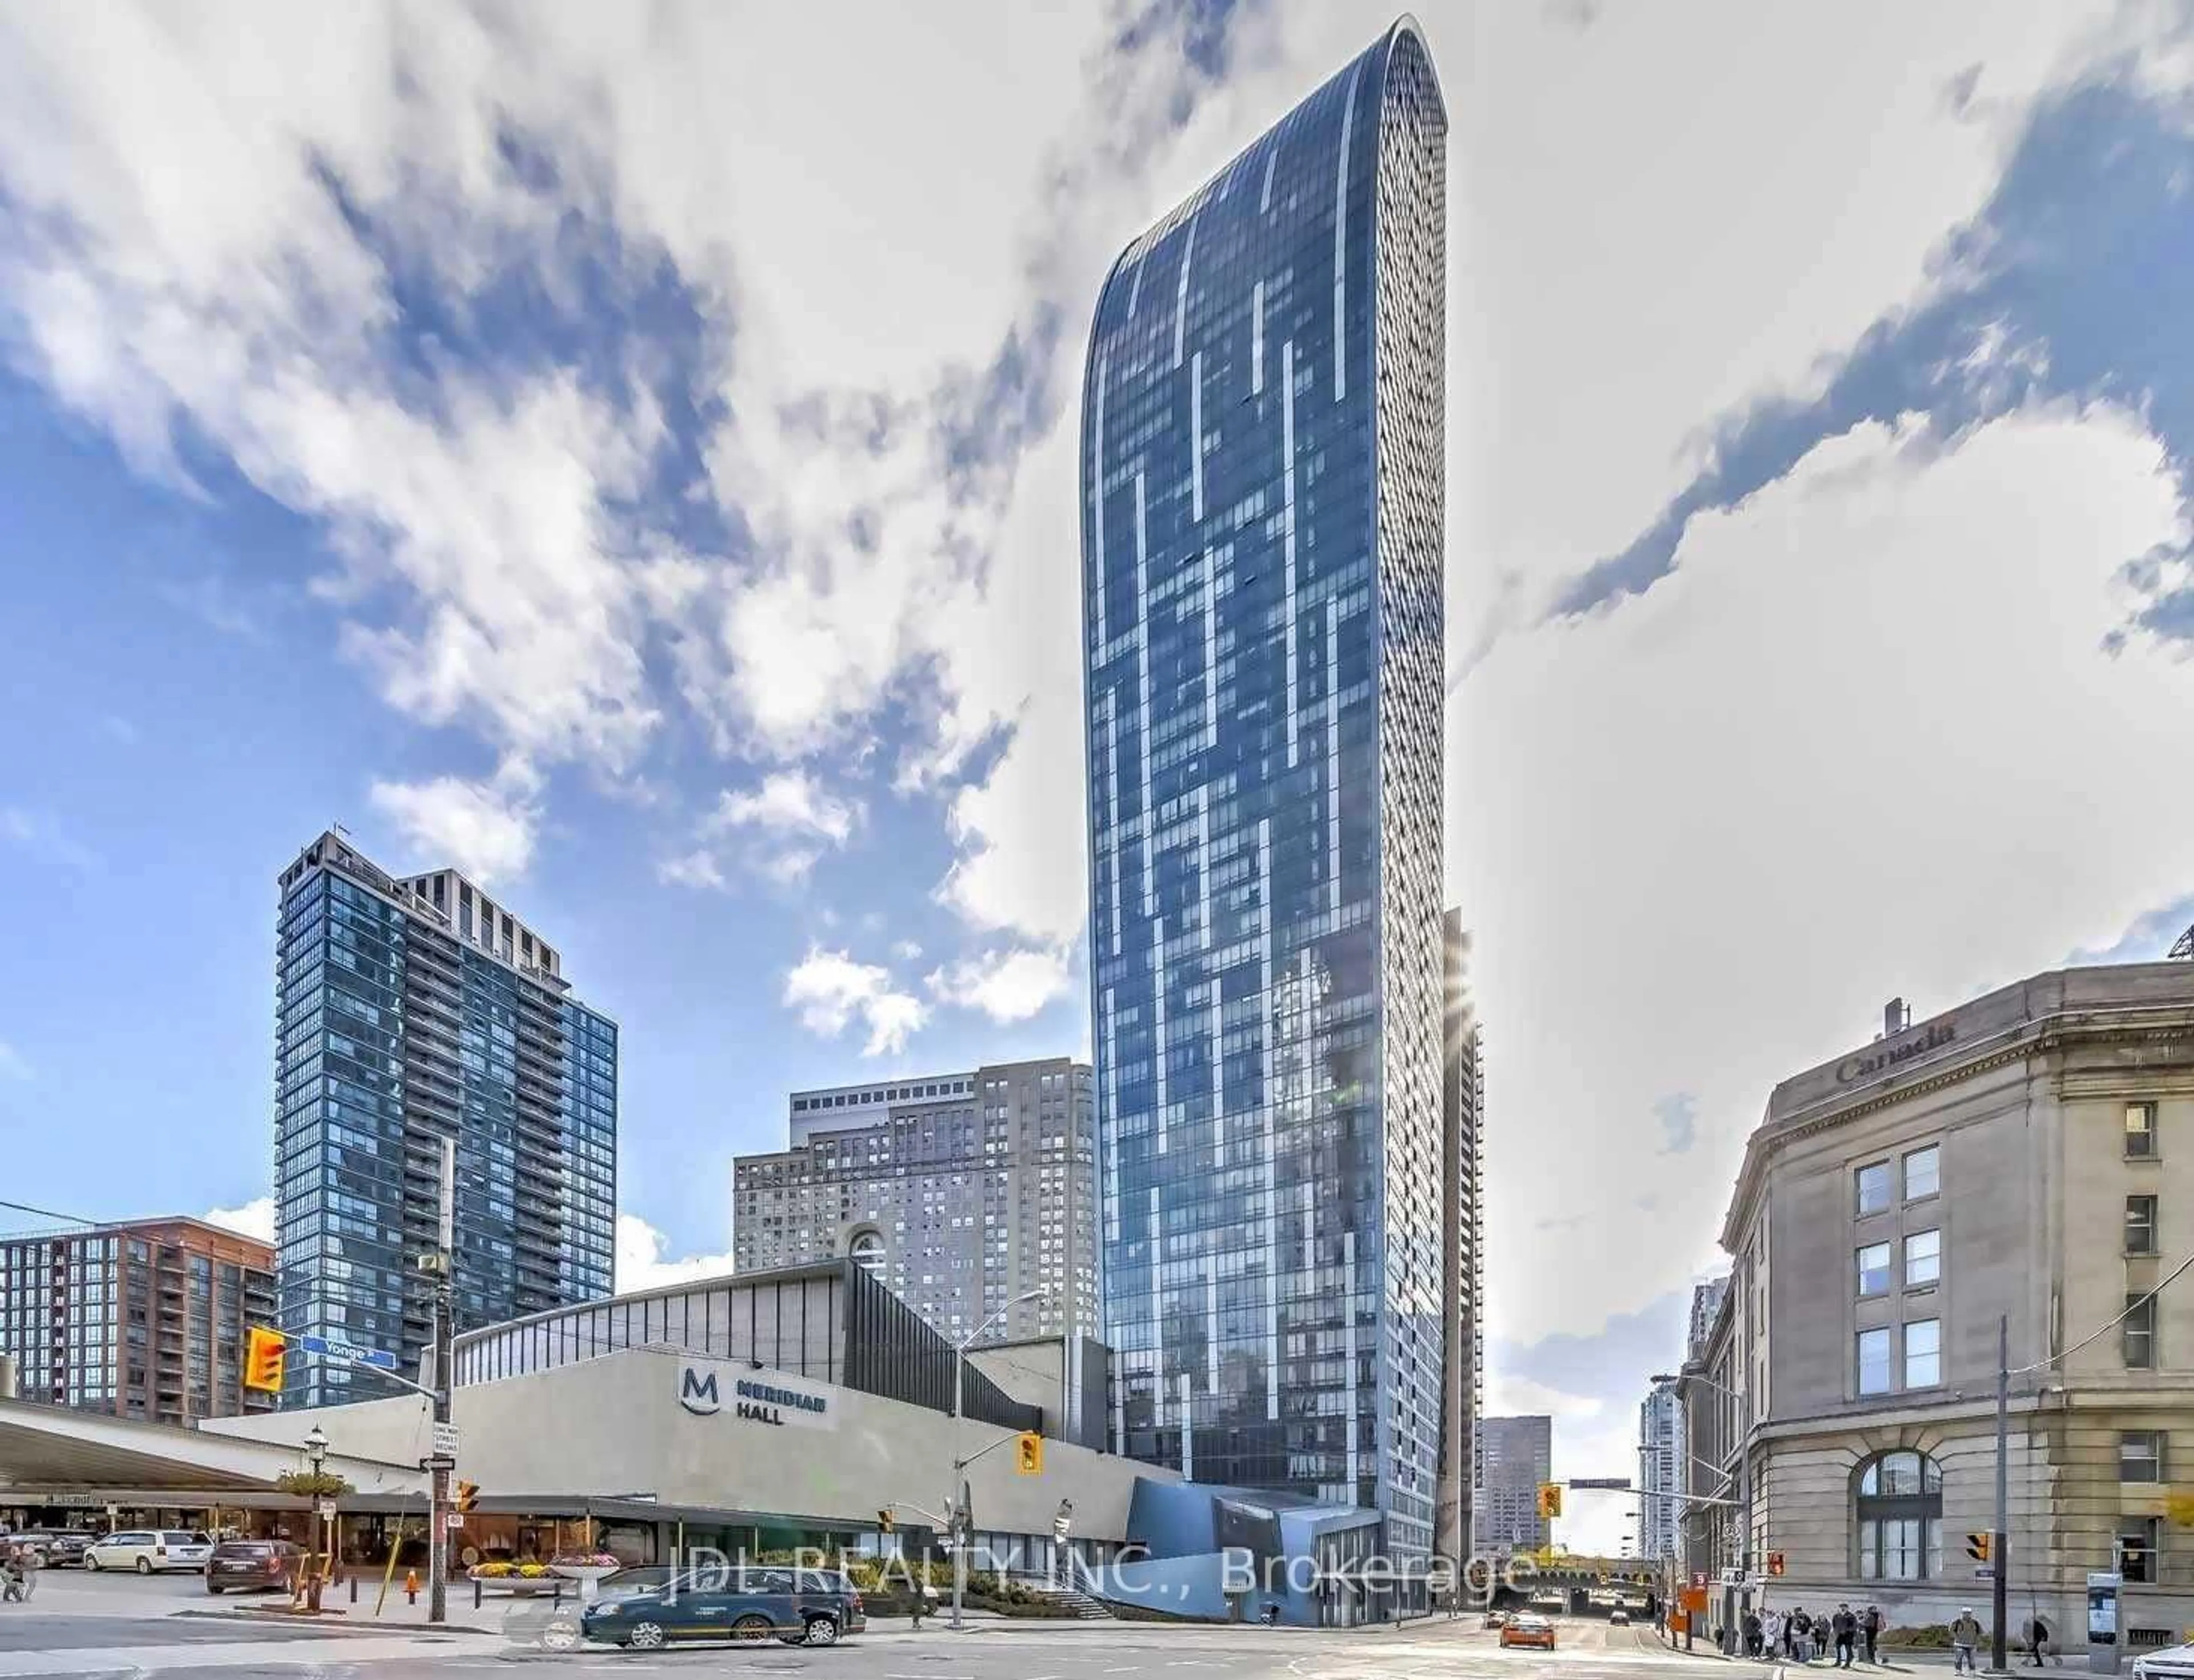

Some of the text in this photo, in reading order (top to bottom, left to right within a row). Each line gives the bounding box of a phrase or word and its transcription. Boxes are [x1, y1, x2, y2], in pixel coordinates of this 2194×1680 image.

[326, 1342, 365, 1359] Yonge
[683, 1367, 719, 1404] M
[737, 1379, 826, 1413] MERIDIAN
[737, 1402, 785, 1426] HALL
